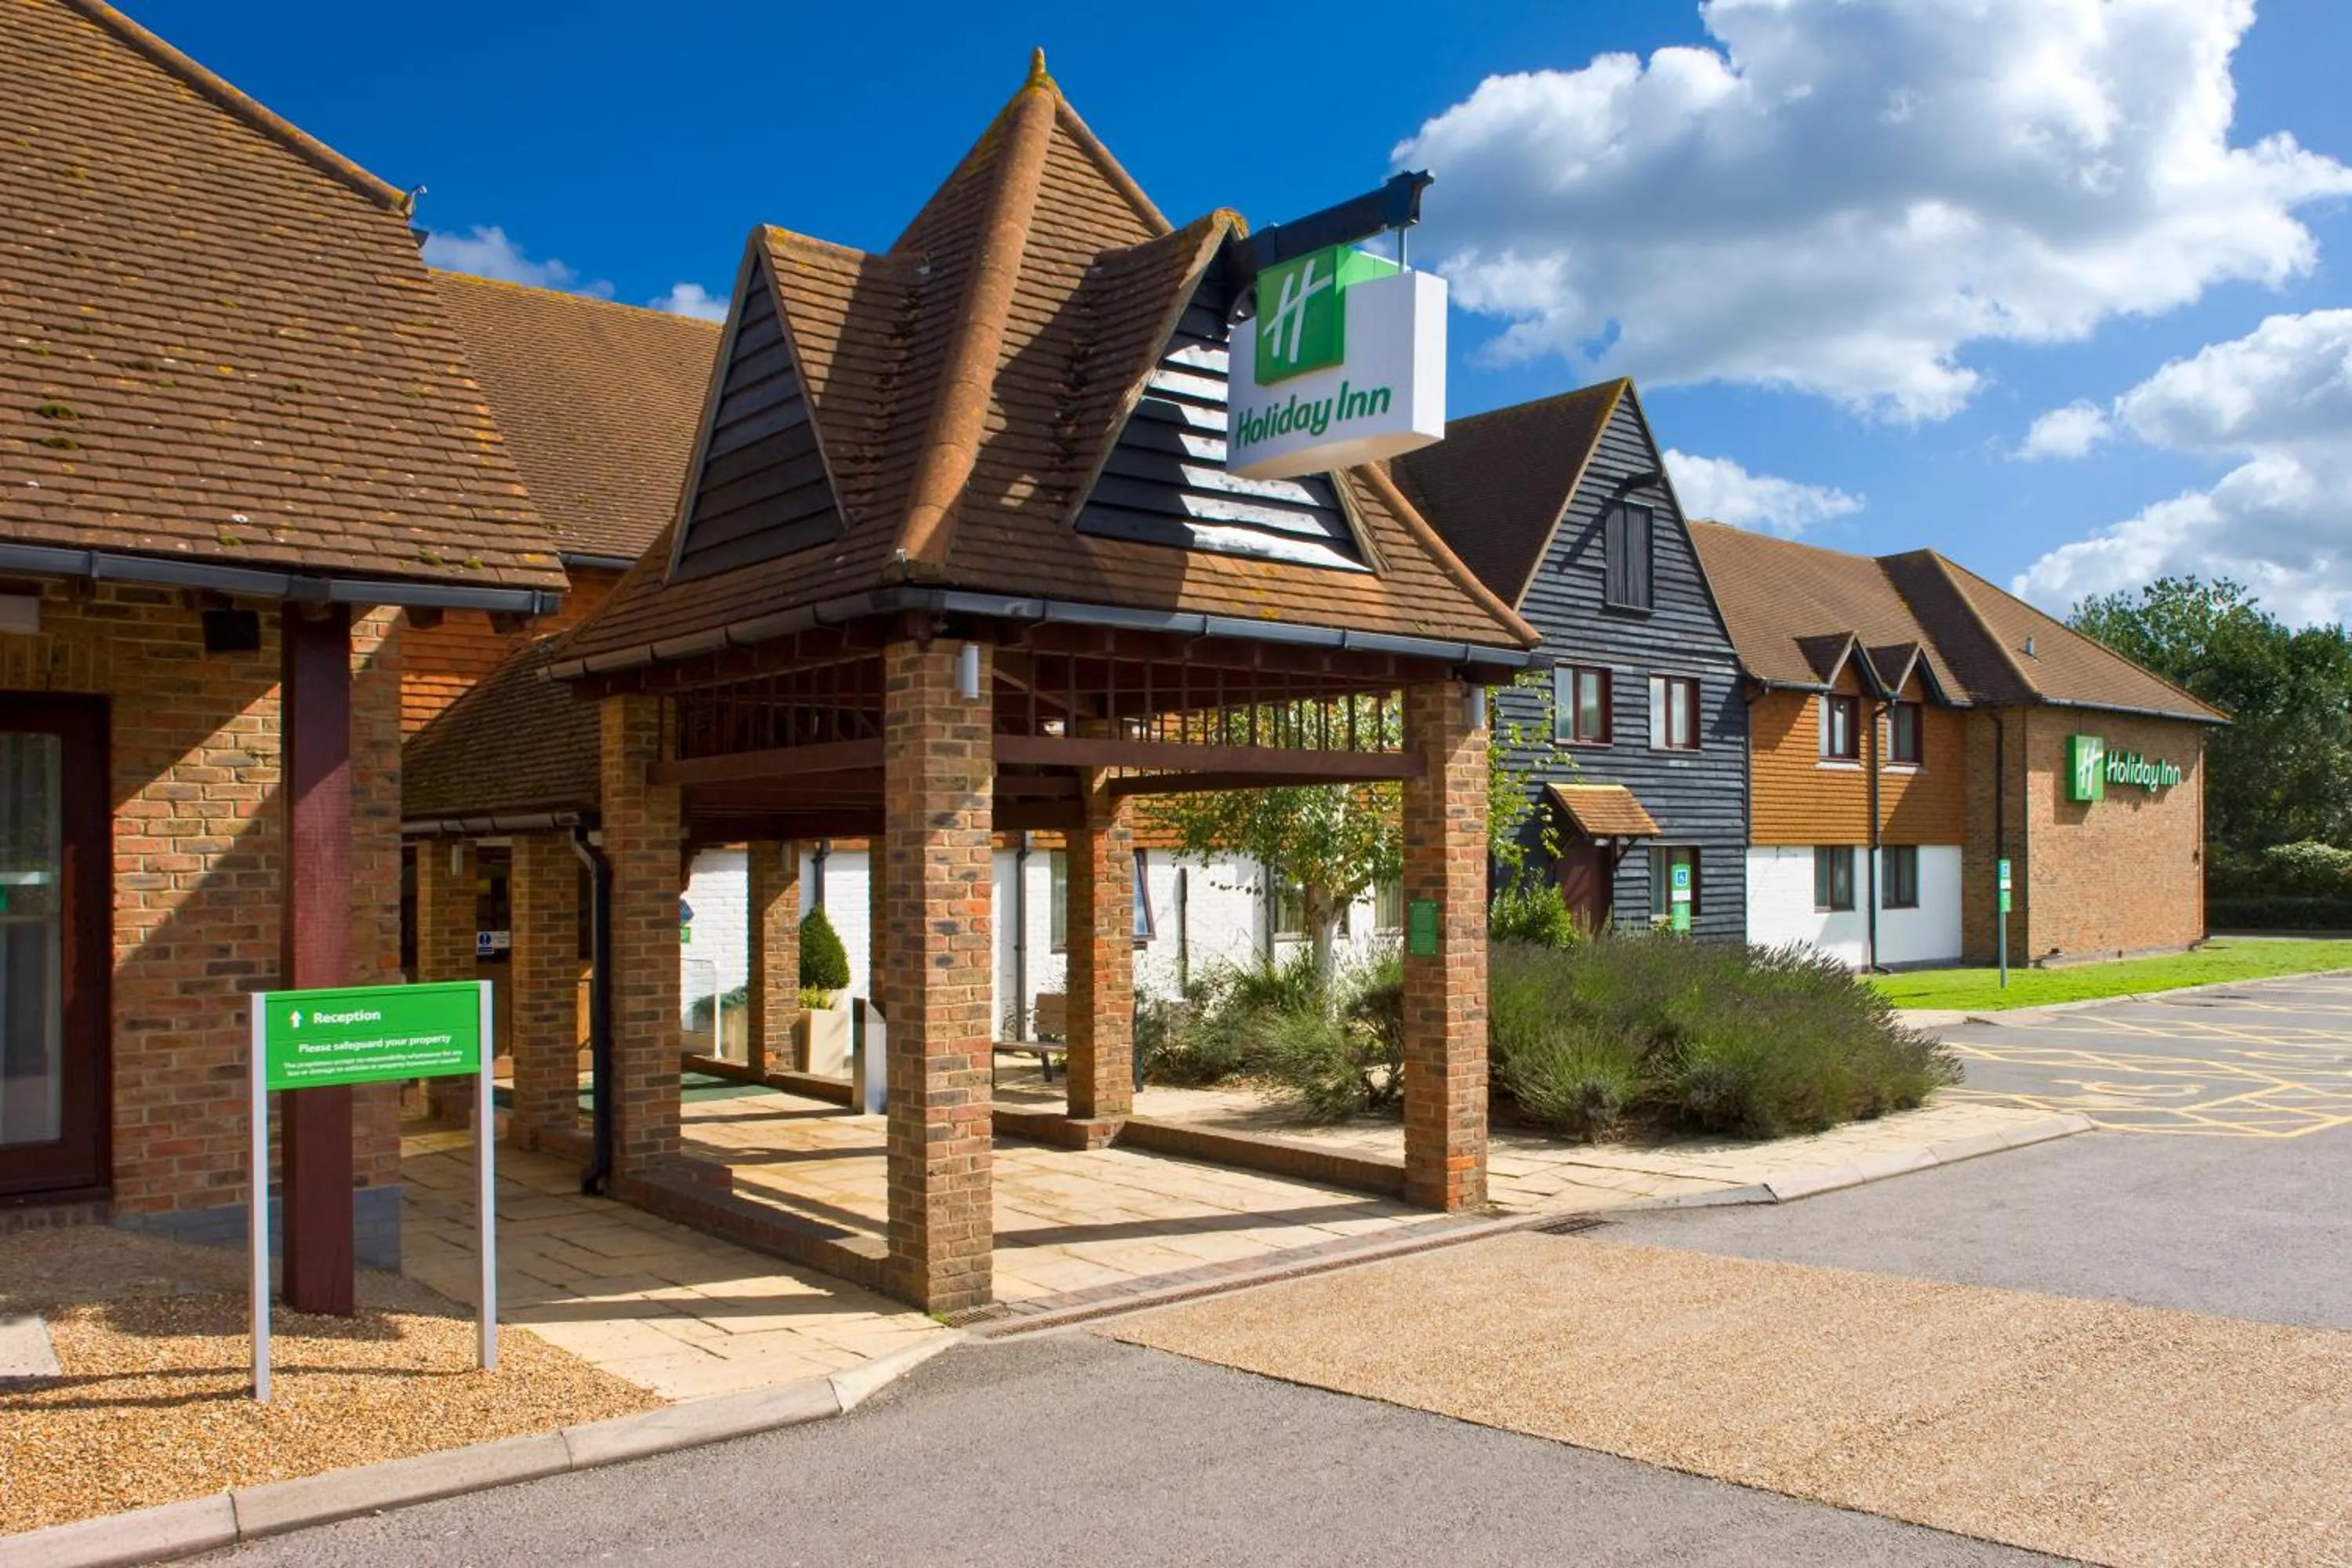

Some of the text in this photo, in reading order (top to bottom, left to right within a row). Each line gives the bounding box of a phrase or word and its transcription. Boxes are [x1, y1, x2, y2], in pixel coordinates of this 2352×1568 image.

[1235, 381, 1392, 450] Holiday Inn
[2107, 750, 2181, 793] Holiday Inn
[313, 1009, 382, 1025] Reception
[299, 1034, 452, 1054] Please safeguard your property
